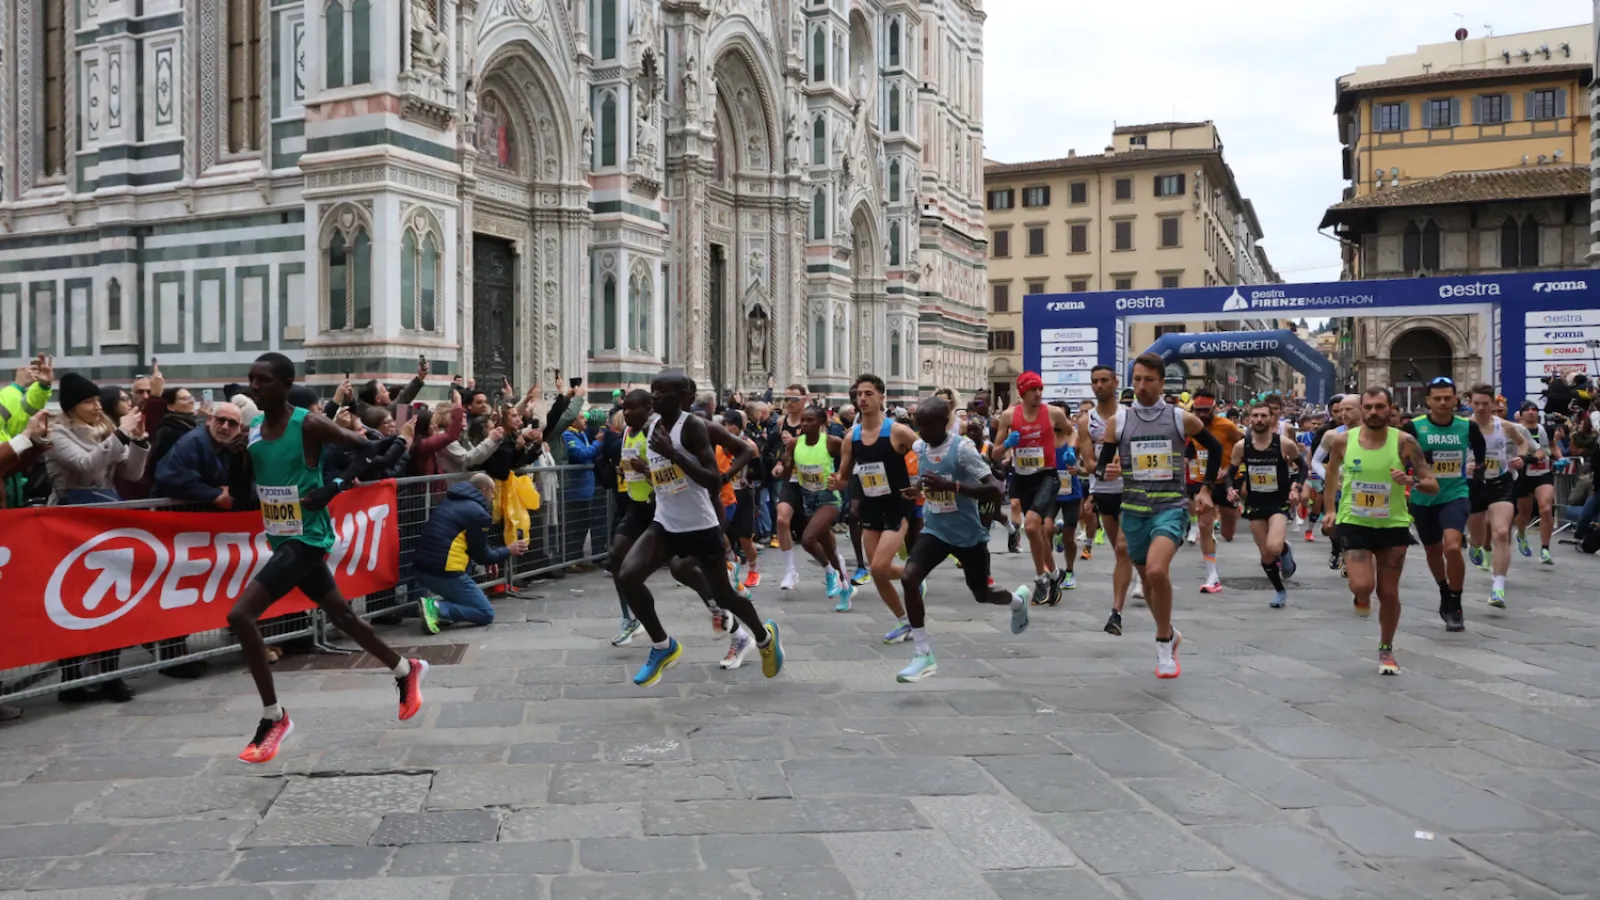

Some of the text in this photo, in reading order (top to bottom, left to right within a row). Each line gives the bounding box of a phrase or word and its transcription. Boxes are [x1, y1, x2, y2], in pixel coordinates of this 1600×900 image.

[1427, 434, 1462, 445] BRASIL
[1147, 454, 1158, 468] 35
[1365, 494, 1375, 507] 19
